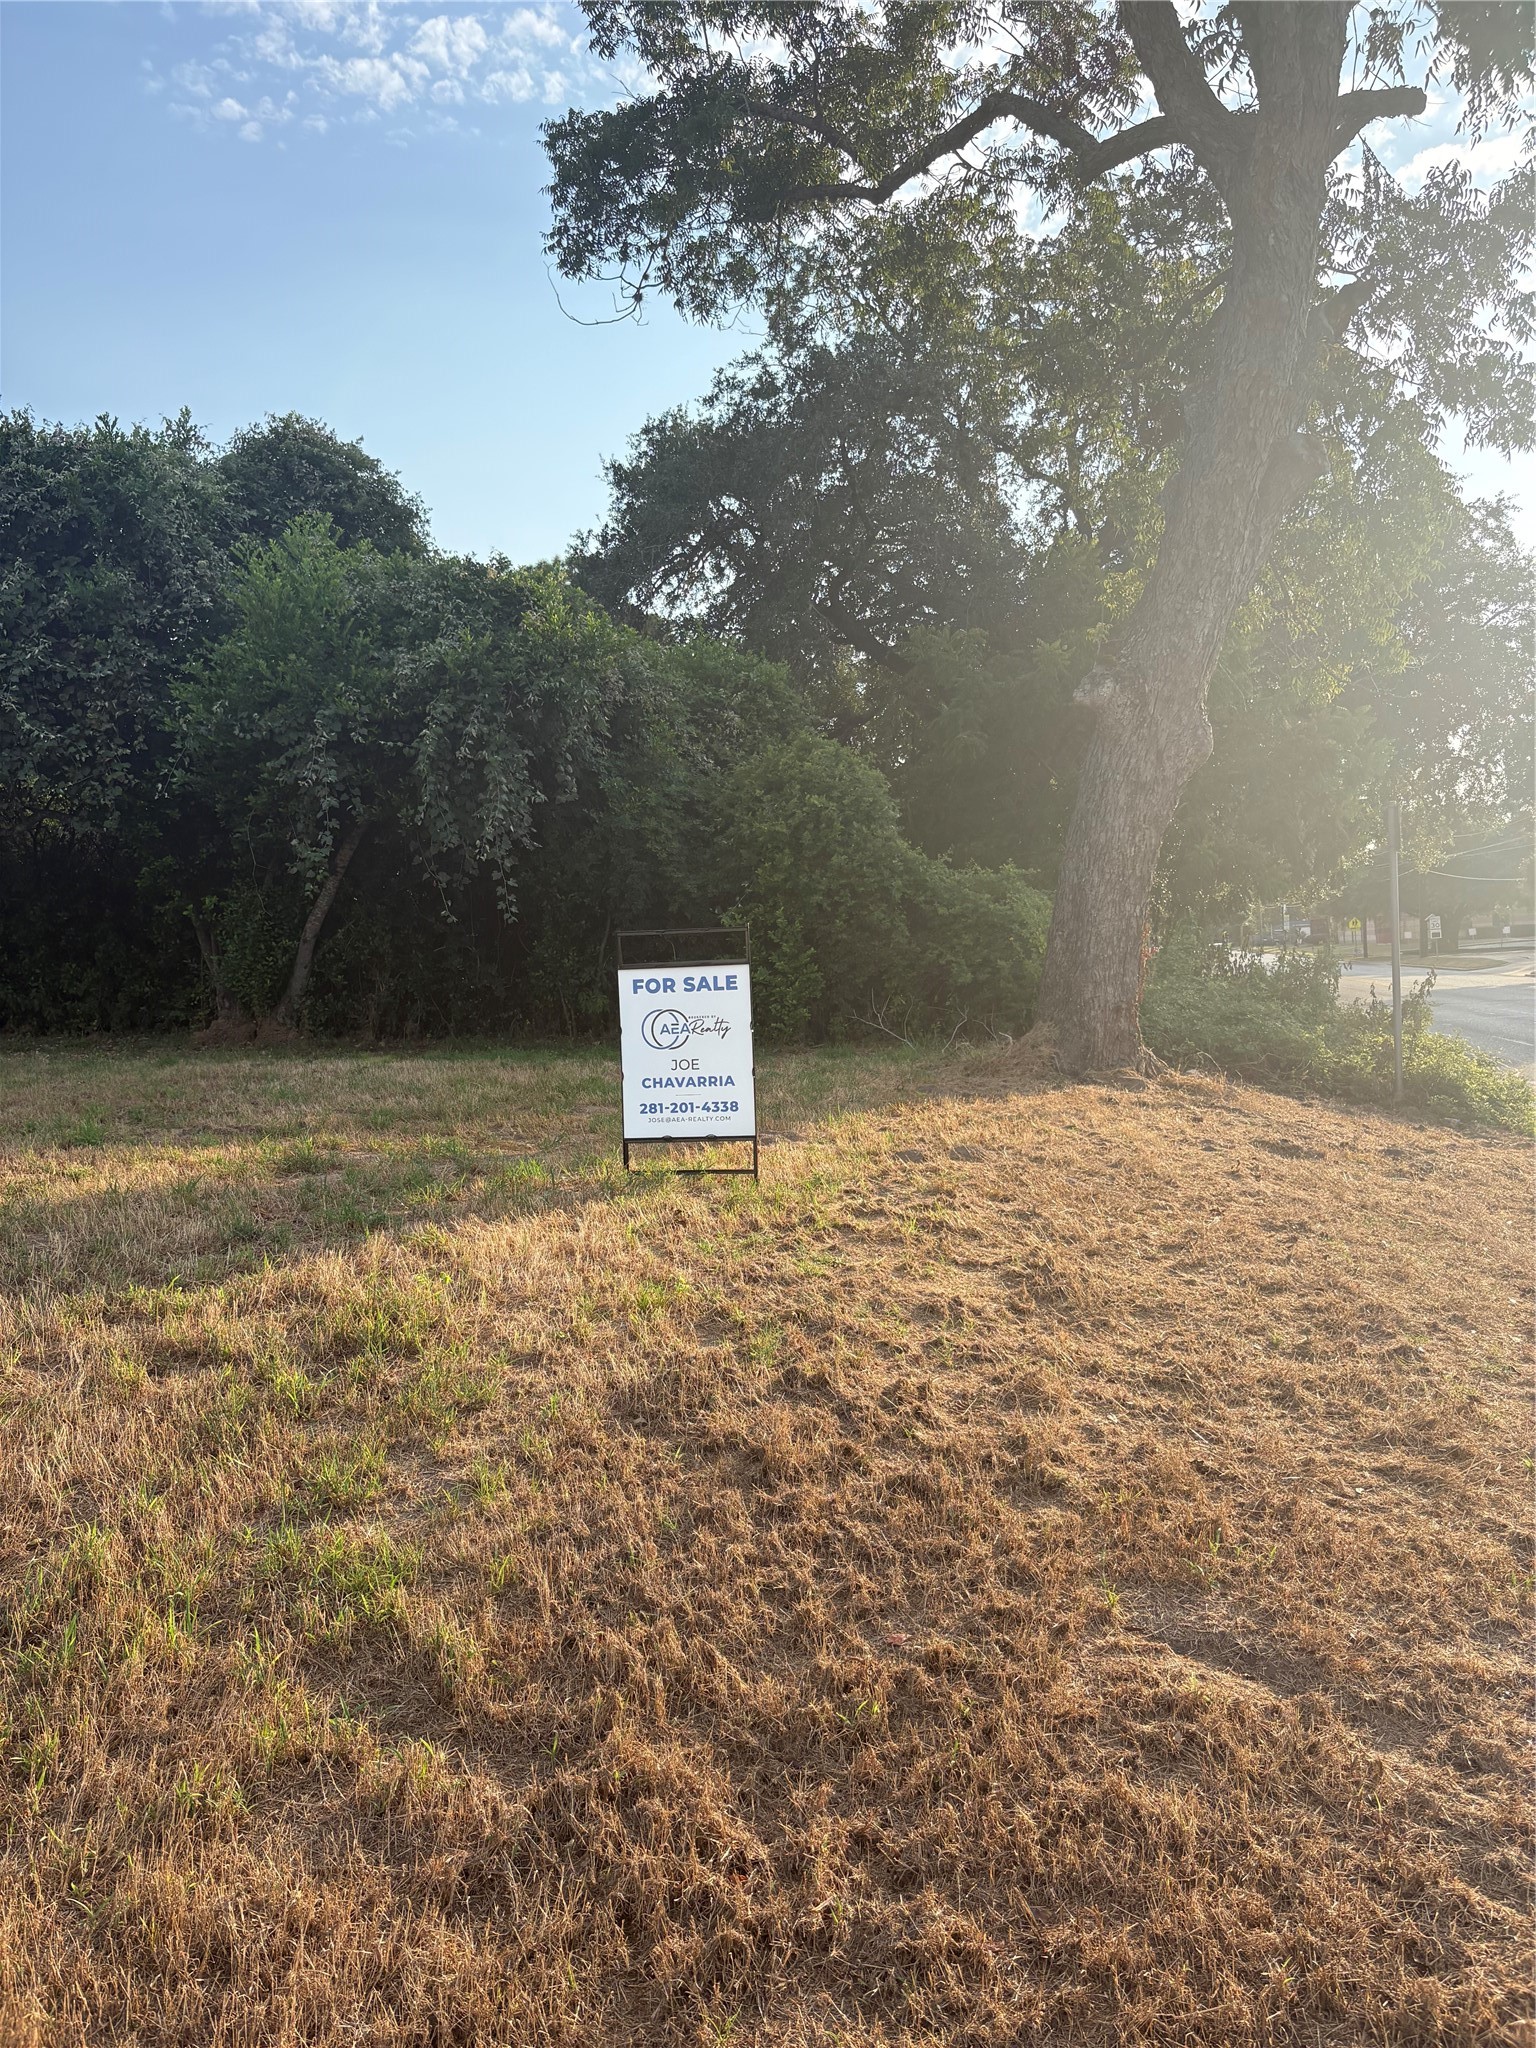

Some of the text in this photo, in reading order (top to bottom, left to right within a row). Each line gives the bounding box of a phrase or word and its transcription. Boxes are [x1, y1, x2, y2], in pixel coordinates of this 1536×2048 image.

[633, 975, 738, 994] FOR SALE
[660, 1017, 731, 1039] AEA Realty
[671, 1058, 700, 1071] JOE
[642, 1075, 736, 1089] CHAVARRIA
[639, 1100, 739, 1114] 281-201-4338
